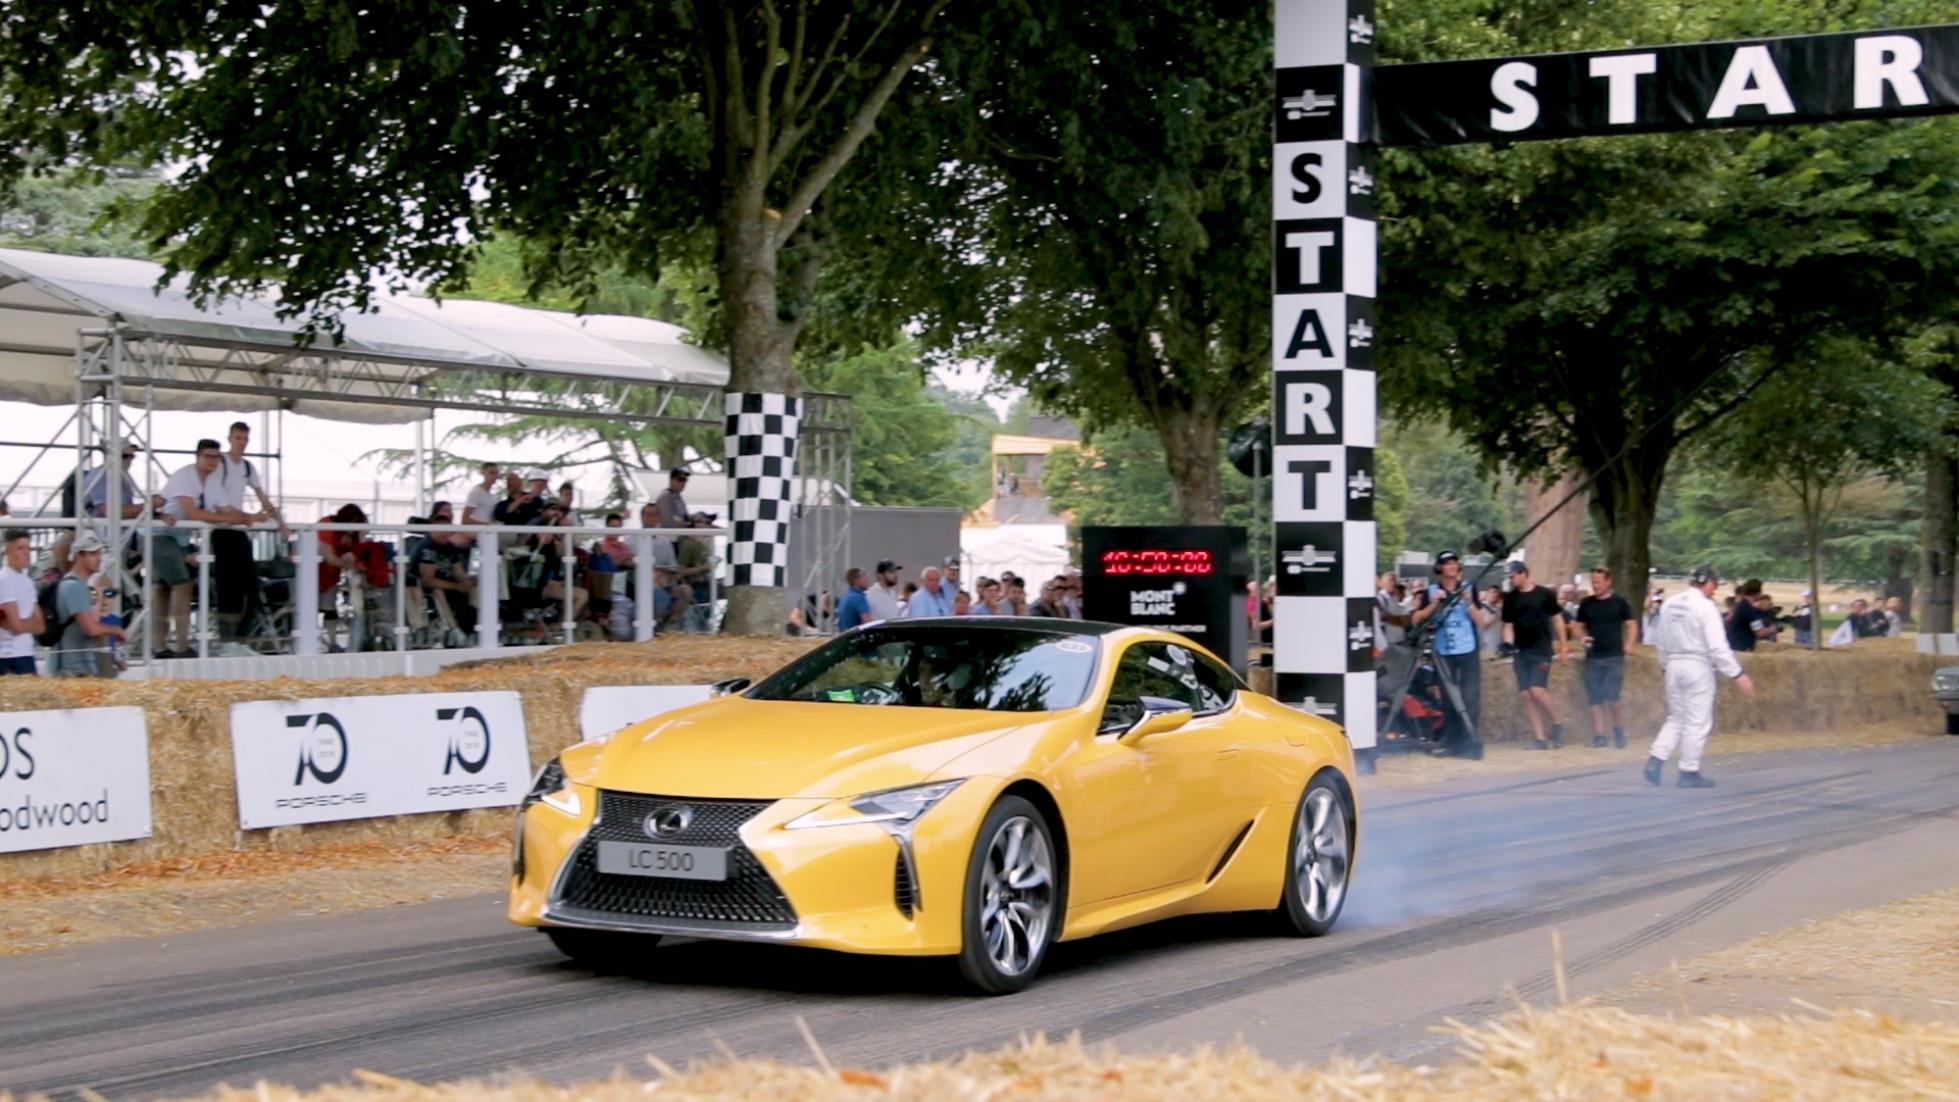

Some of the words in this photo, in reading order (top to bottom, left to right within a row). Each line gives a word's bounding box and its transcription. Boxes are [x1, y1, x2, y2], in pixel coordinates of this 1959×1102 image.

[1489, 35, 1930, 132] STAR
[1284, 152, 1337, 511] START
[1130, 590, 1175, 602] MONT
[1130, 603, 1176, 615] BLANC
[285, 712, 348, 786] 70
[435, 705, 491, 776] 70
[276, 791, 368, 811] PORSCHE
[427, 781, 508, 798] PORSCHE
[628, 849, 652, 869] LC
[656, 850, 695, 872] 500
